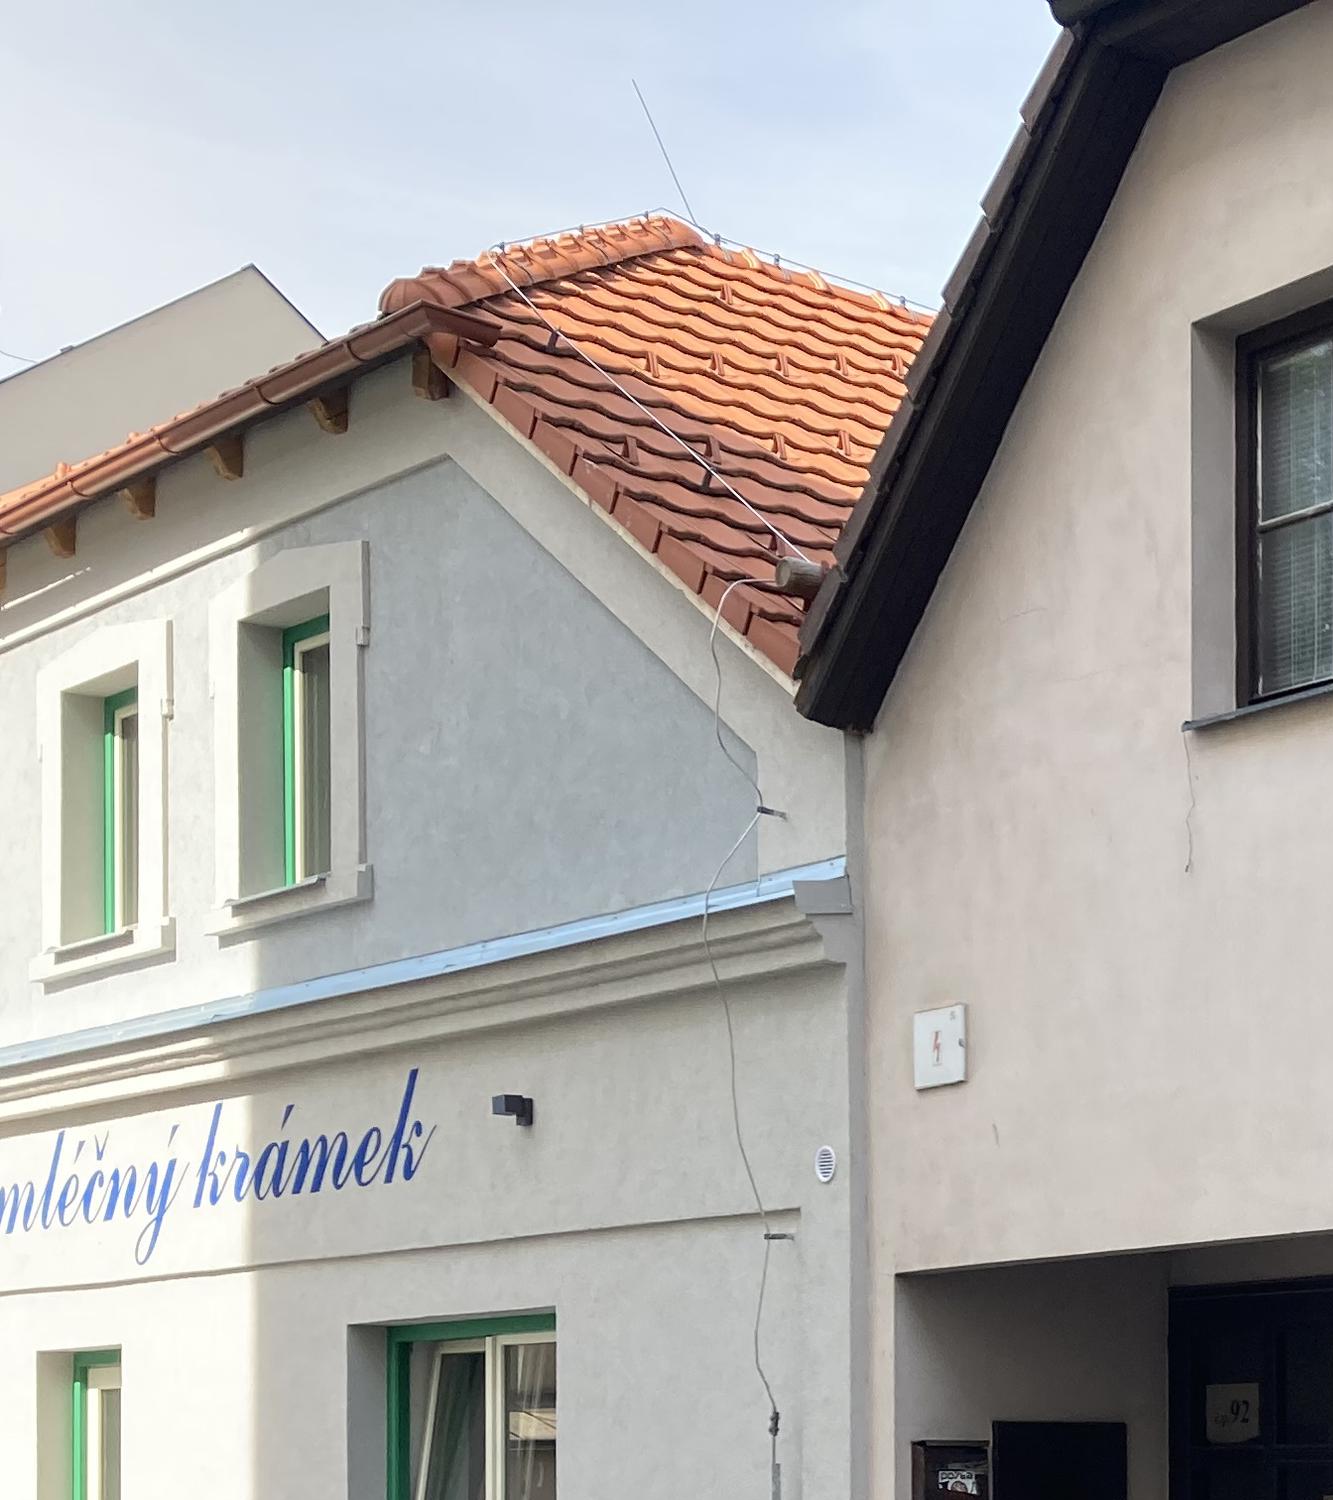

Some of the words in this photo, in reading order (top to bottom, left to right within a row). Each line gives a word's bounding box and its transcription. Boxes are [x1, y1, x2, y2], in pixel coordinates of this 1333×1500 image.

[0, 1124, 190, 1266] mléčný
[193, 1068, 437, 1208] krámek
[1231, 1399, 1249, 1424] 92
